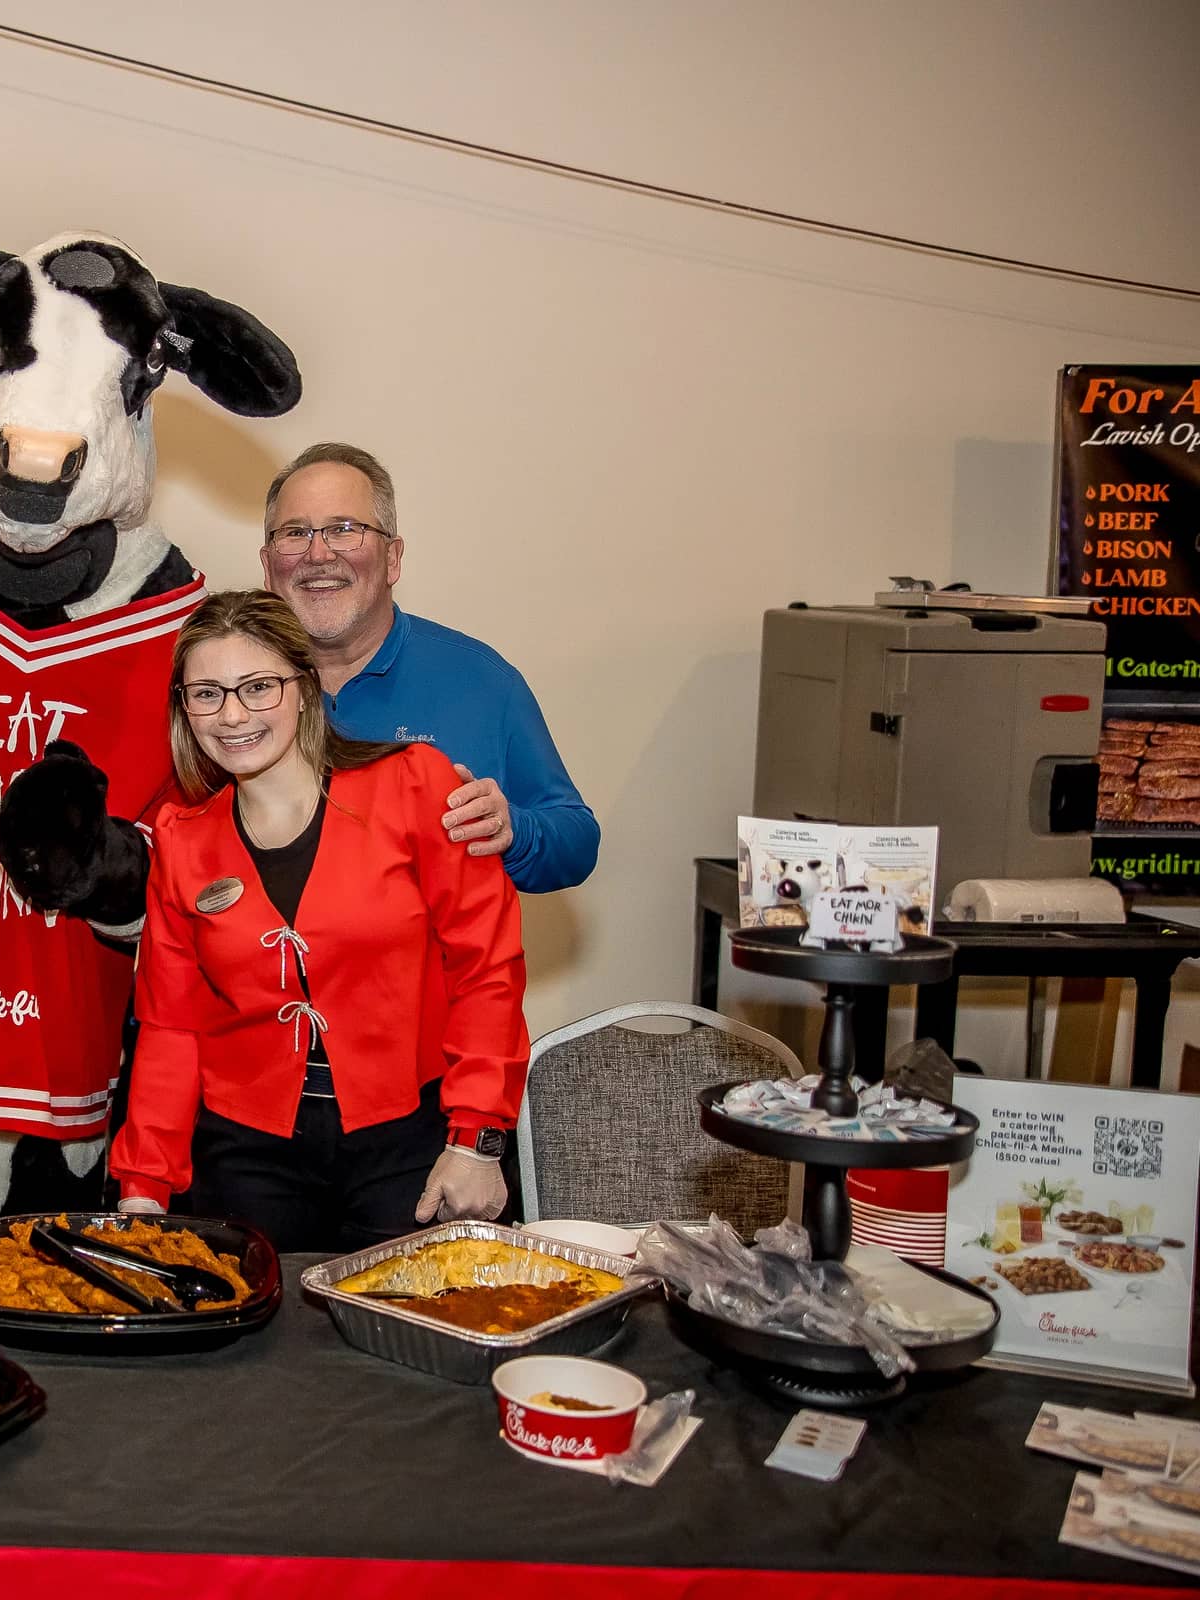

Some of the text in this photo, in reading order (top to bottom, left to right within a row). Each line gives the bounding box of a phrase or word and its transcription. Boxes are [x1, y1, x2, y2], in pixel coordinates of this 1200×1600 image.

[1080, 379, 1164, 414] For
[1080, 422, 1165, 446] Lavish
[1100, 484, 1170, 502] PORK
[1098, 512, 1159, 530] BEEF
[1096, 540, 1172, 559] BISON
[1095, 569, 1167, 587] LAMB
[831, 897, 881, 912] EAT MOR
[834, 911, 873, 925] CHIKIN
[992, 1108, 1064, 1122] Enter to WIN
[991, 1130, 1064, 1144] package with
[1000, 1121, 1056, 1135] a catering
[975, 1138, 1082, 1156] Chick-fil-A Medina
[995, 1151, 1061, 1167] ($500 value)
[506, 1402, 597, 1456] Chick-fil-A
